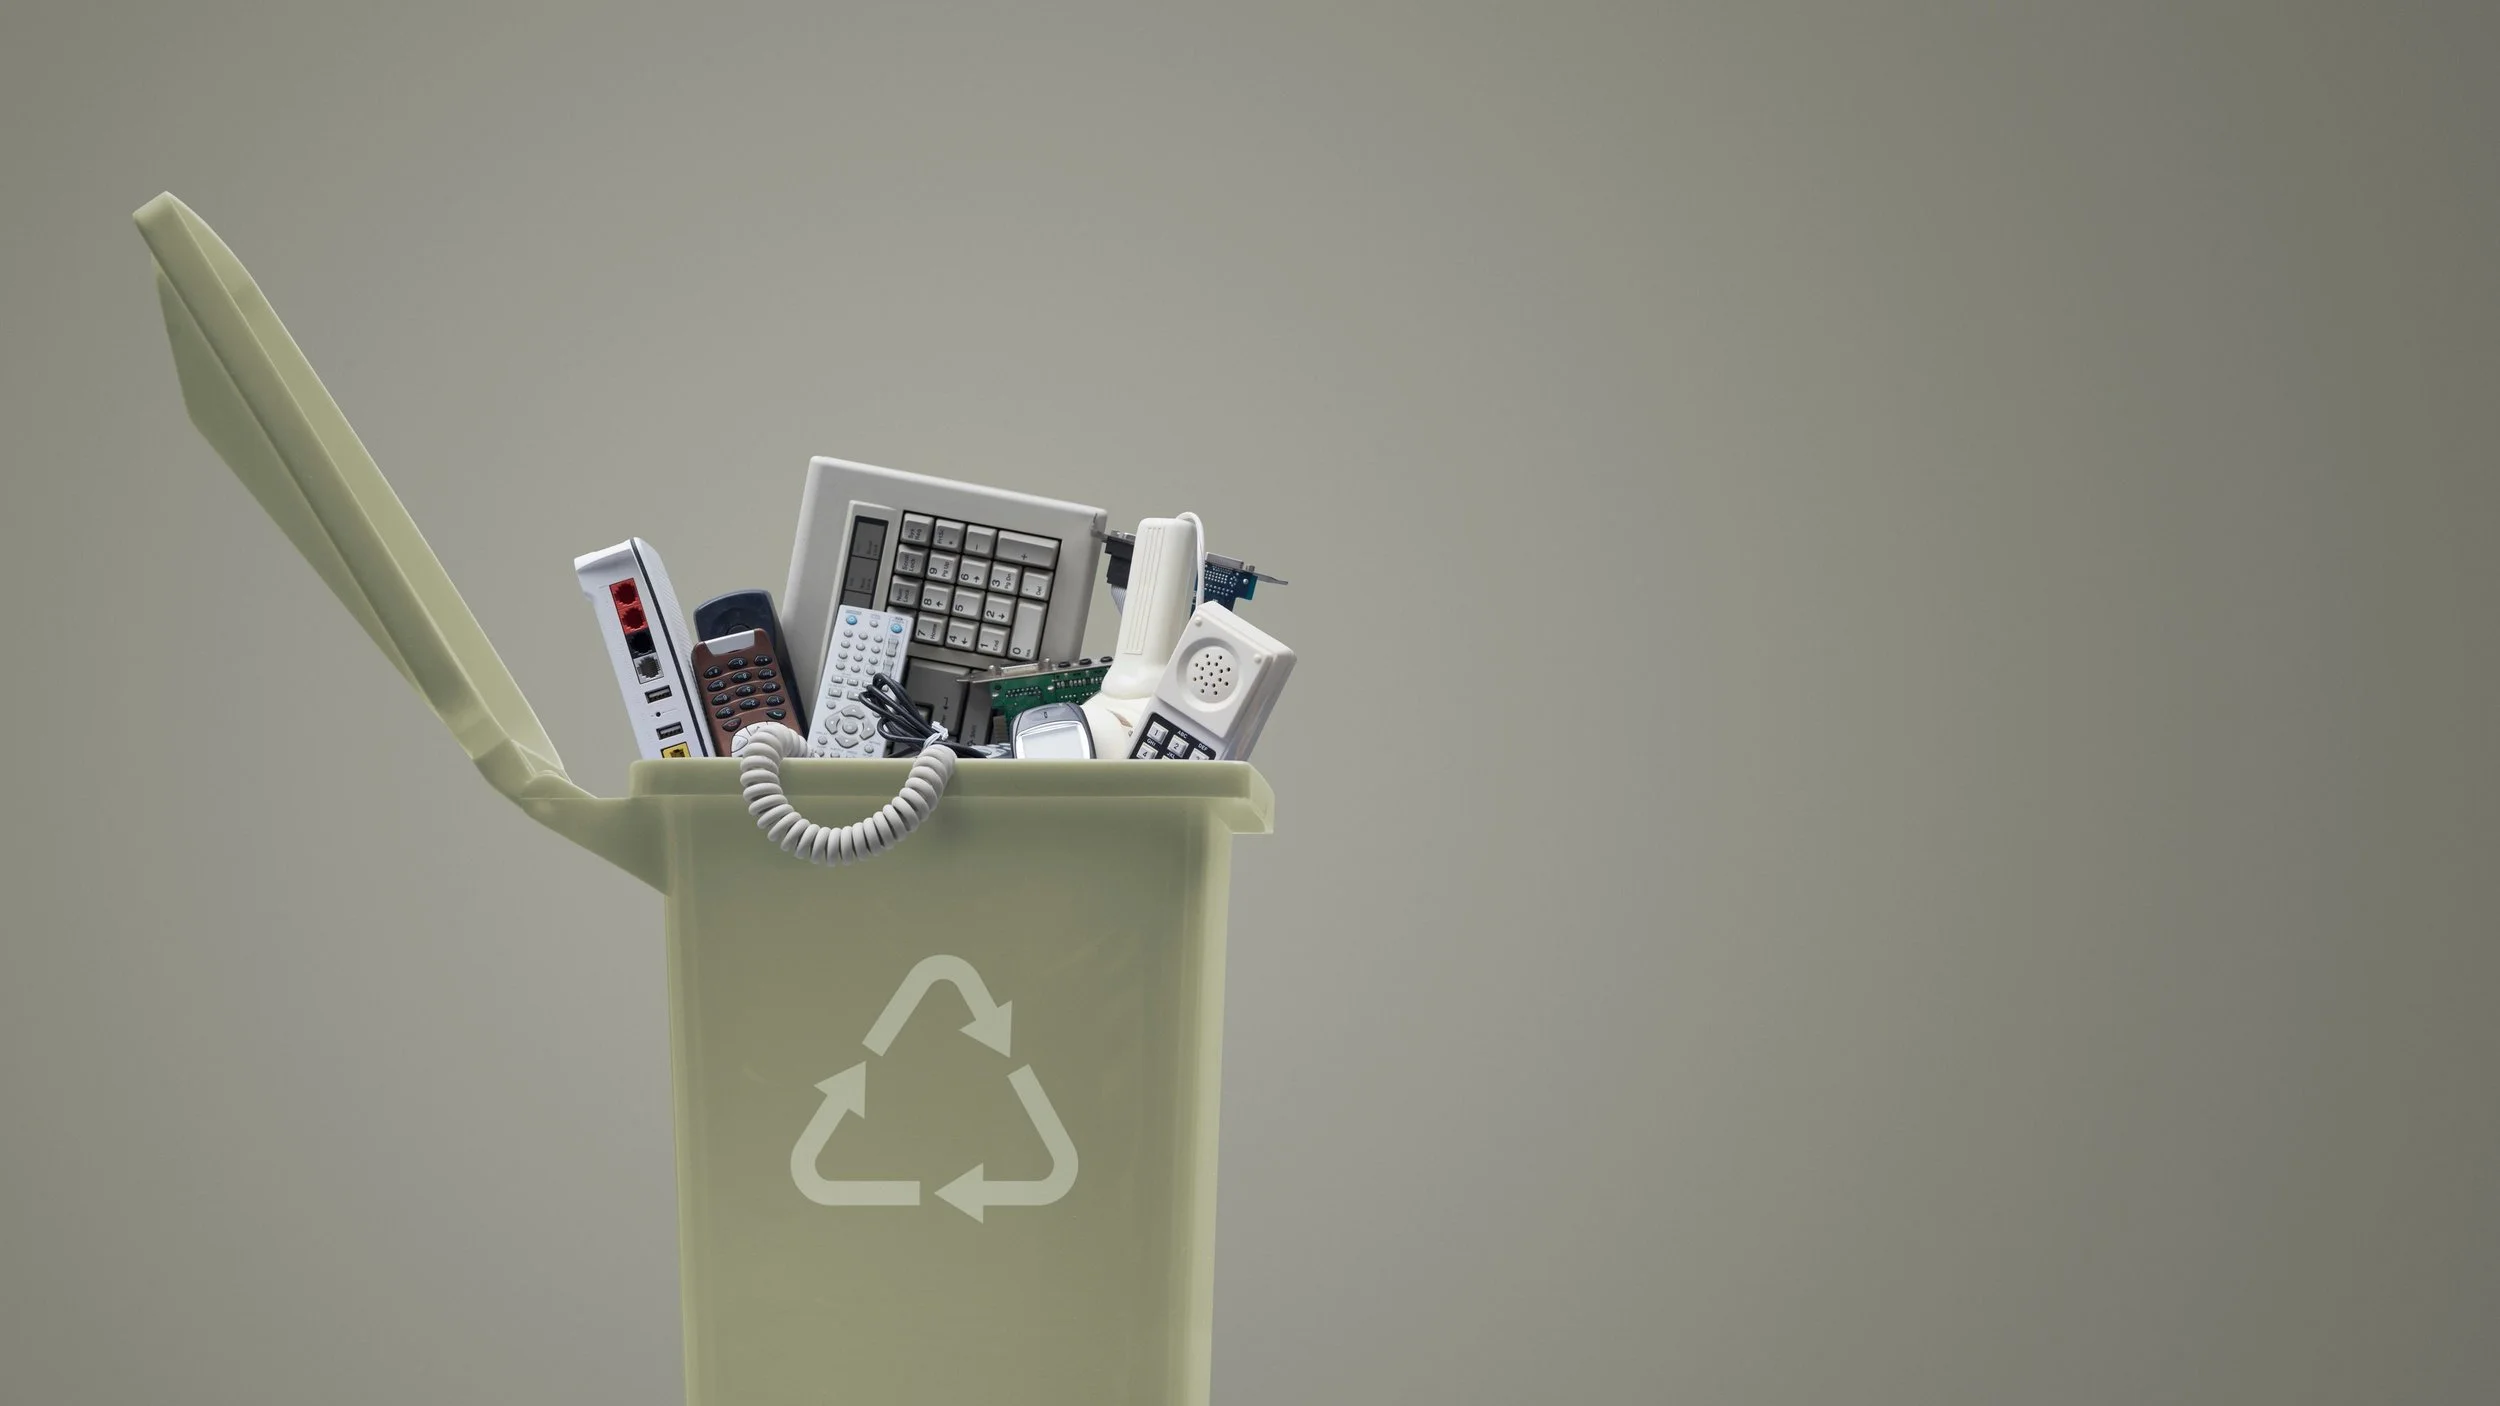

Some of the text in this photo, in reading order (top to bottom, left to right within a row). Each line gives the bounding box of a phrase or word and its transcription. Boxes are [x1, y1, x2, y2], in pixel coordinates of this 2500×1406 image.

[992, 579, 1000, 588] 3
[1177, 730, 1188, 739] ABC
[1197, 743, 1209, 751] DEF
